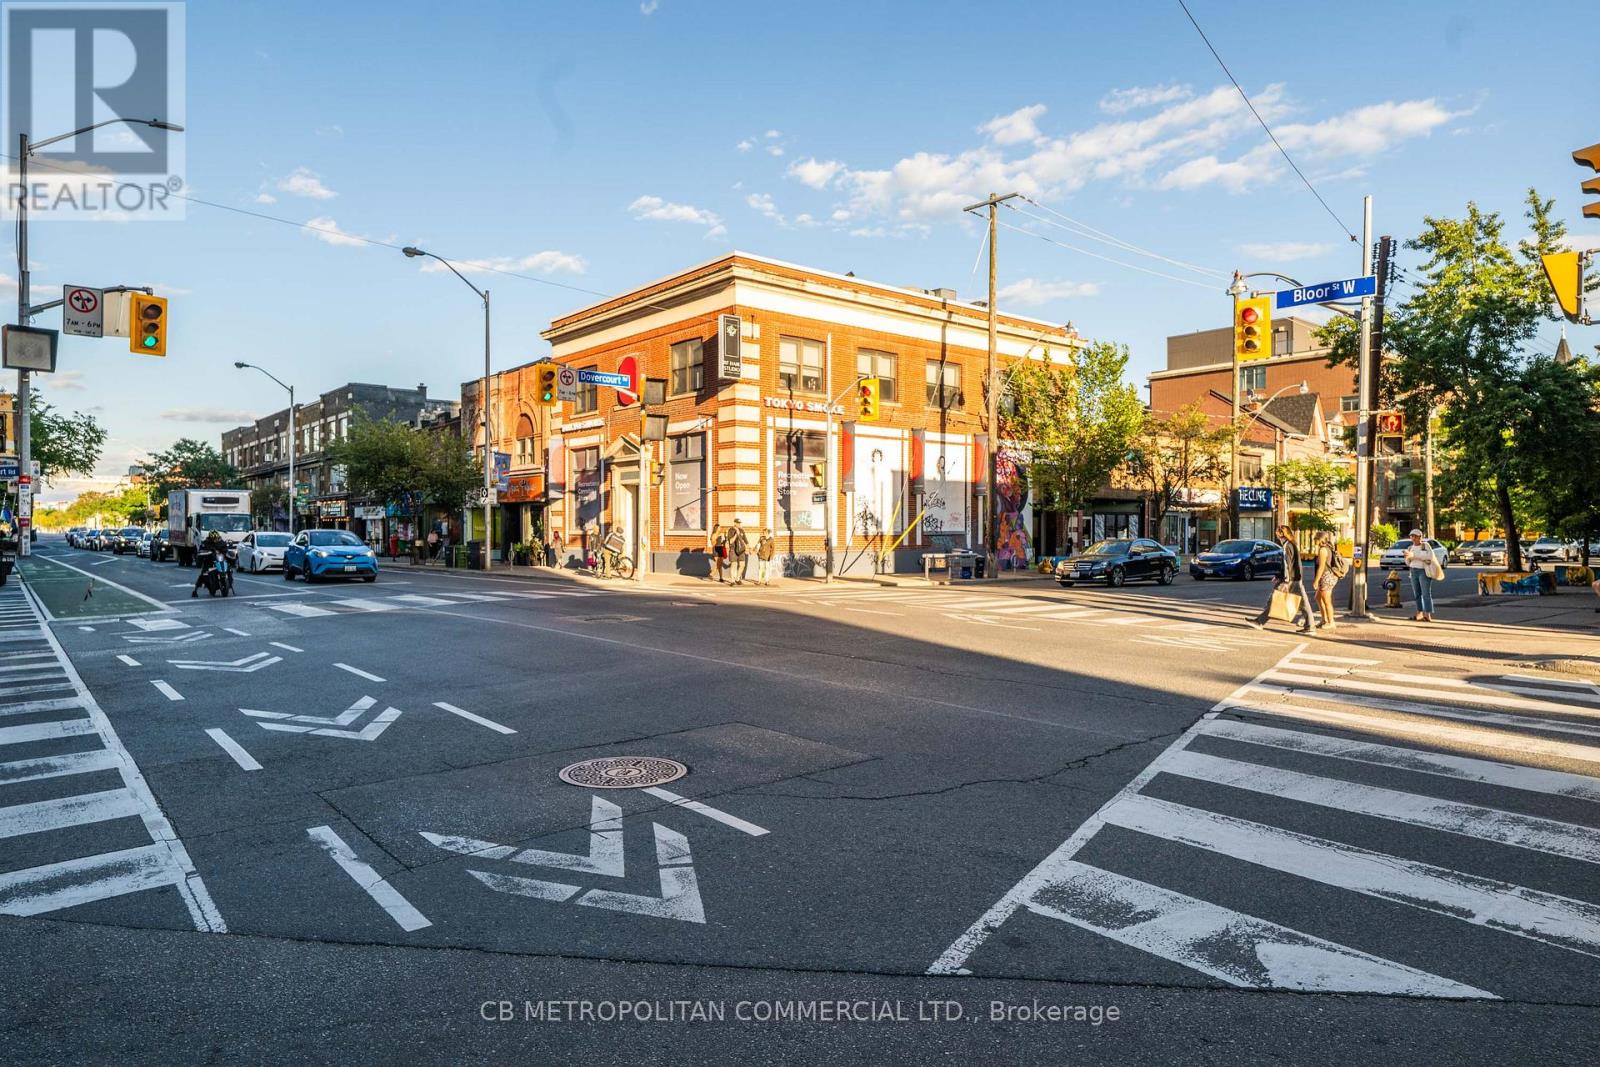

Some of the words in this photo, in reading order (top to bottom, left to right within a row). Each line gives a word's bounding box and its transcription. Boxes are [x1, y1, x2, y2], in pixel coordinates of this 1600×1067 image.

[1293, 286, 1330, 303] Bloor
[1332, 283, 1340, 291] St
[1343, 280, 1356, 295] W
[580, 371, 622, 385] Dovercourt
[763, 396, 804, 411] TOKYO
[807, 401, 845, 415] SMOKE
[674, 471, 689, 481] Now
[674, 481, 690, 491] Open
